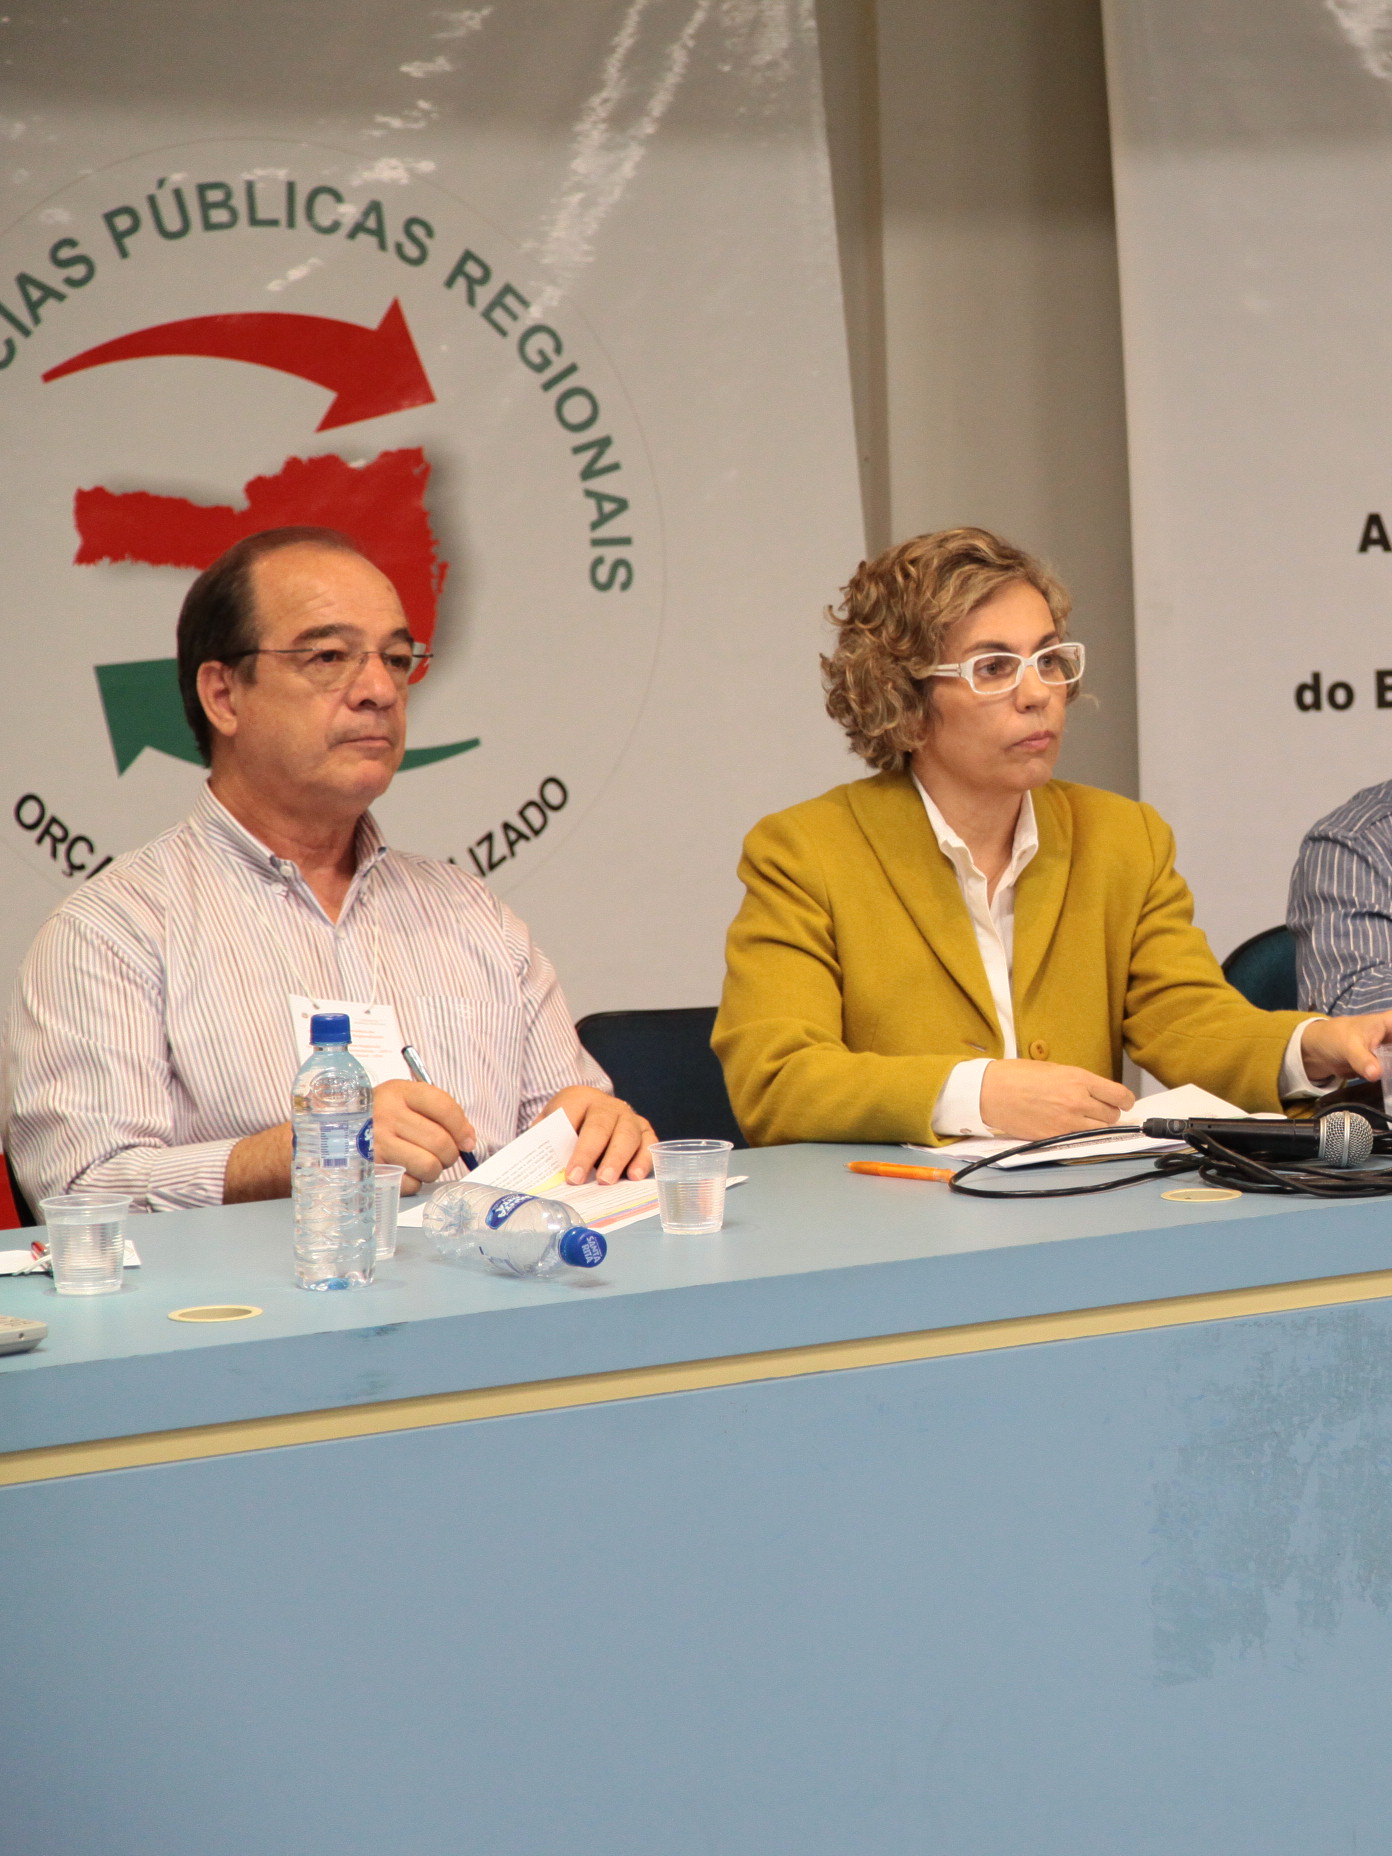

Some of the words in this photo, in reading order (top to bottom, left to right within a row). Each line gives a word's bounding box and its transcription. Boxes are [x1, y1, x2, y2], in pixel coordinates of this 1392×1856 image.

[103, 177, 435, 266] PÚBLICAS
[443, 249, 634, 592] REGIONAIS
[1294, 671, 1354, 712] do
